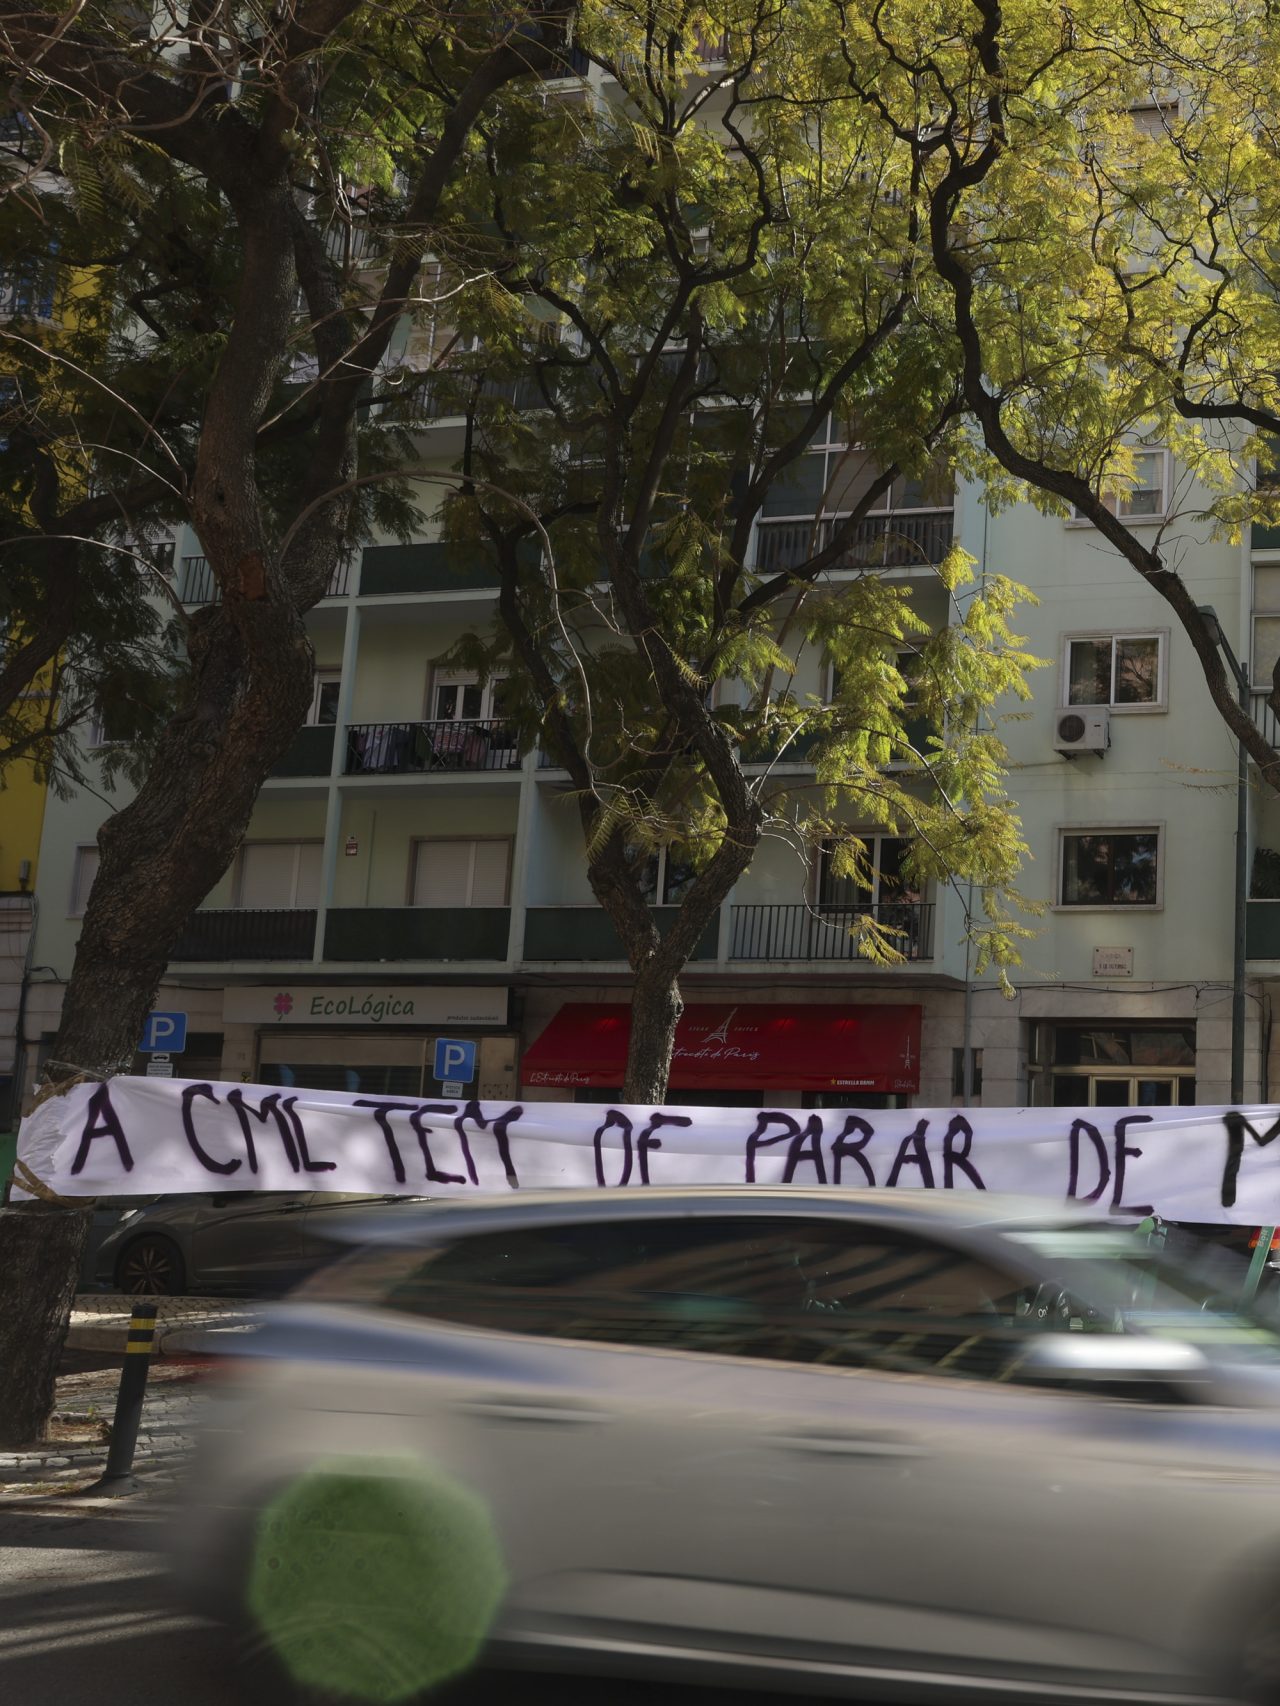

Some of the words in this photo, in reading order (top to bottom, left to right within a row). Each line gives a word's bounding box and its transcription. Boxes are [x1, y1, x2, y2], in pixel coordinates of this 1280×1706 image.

[310, 993, 415, 1022] EcoLógica
[150, 1016, 175, 1047] P
[444, 1044, 465, 1076] P
[71, 1082, 134, 1175] A
[182, 1083, 336, 1175] CML
[746, 1111, 986, 1191] PARAR
[1066, 1115, 1155, 1215] DE
